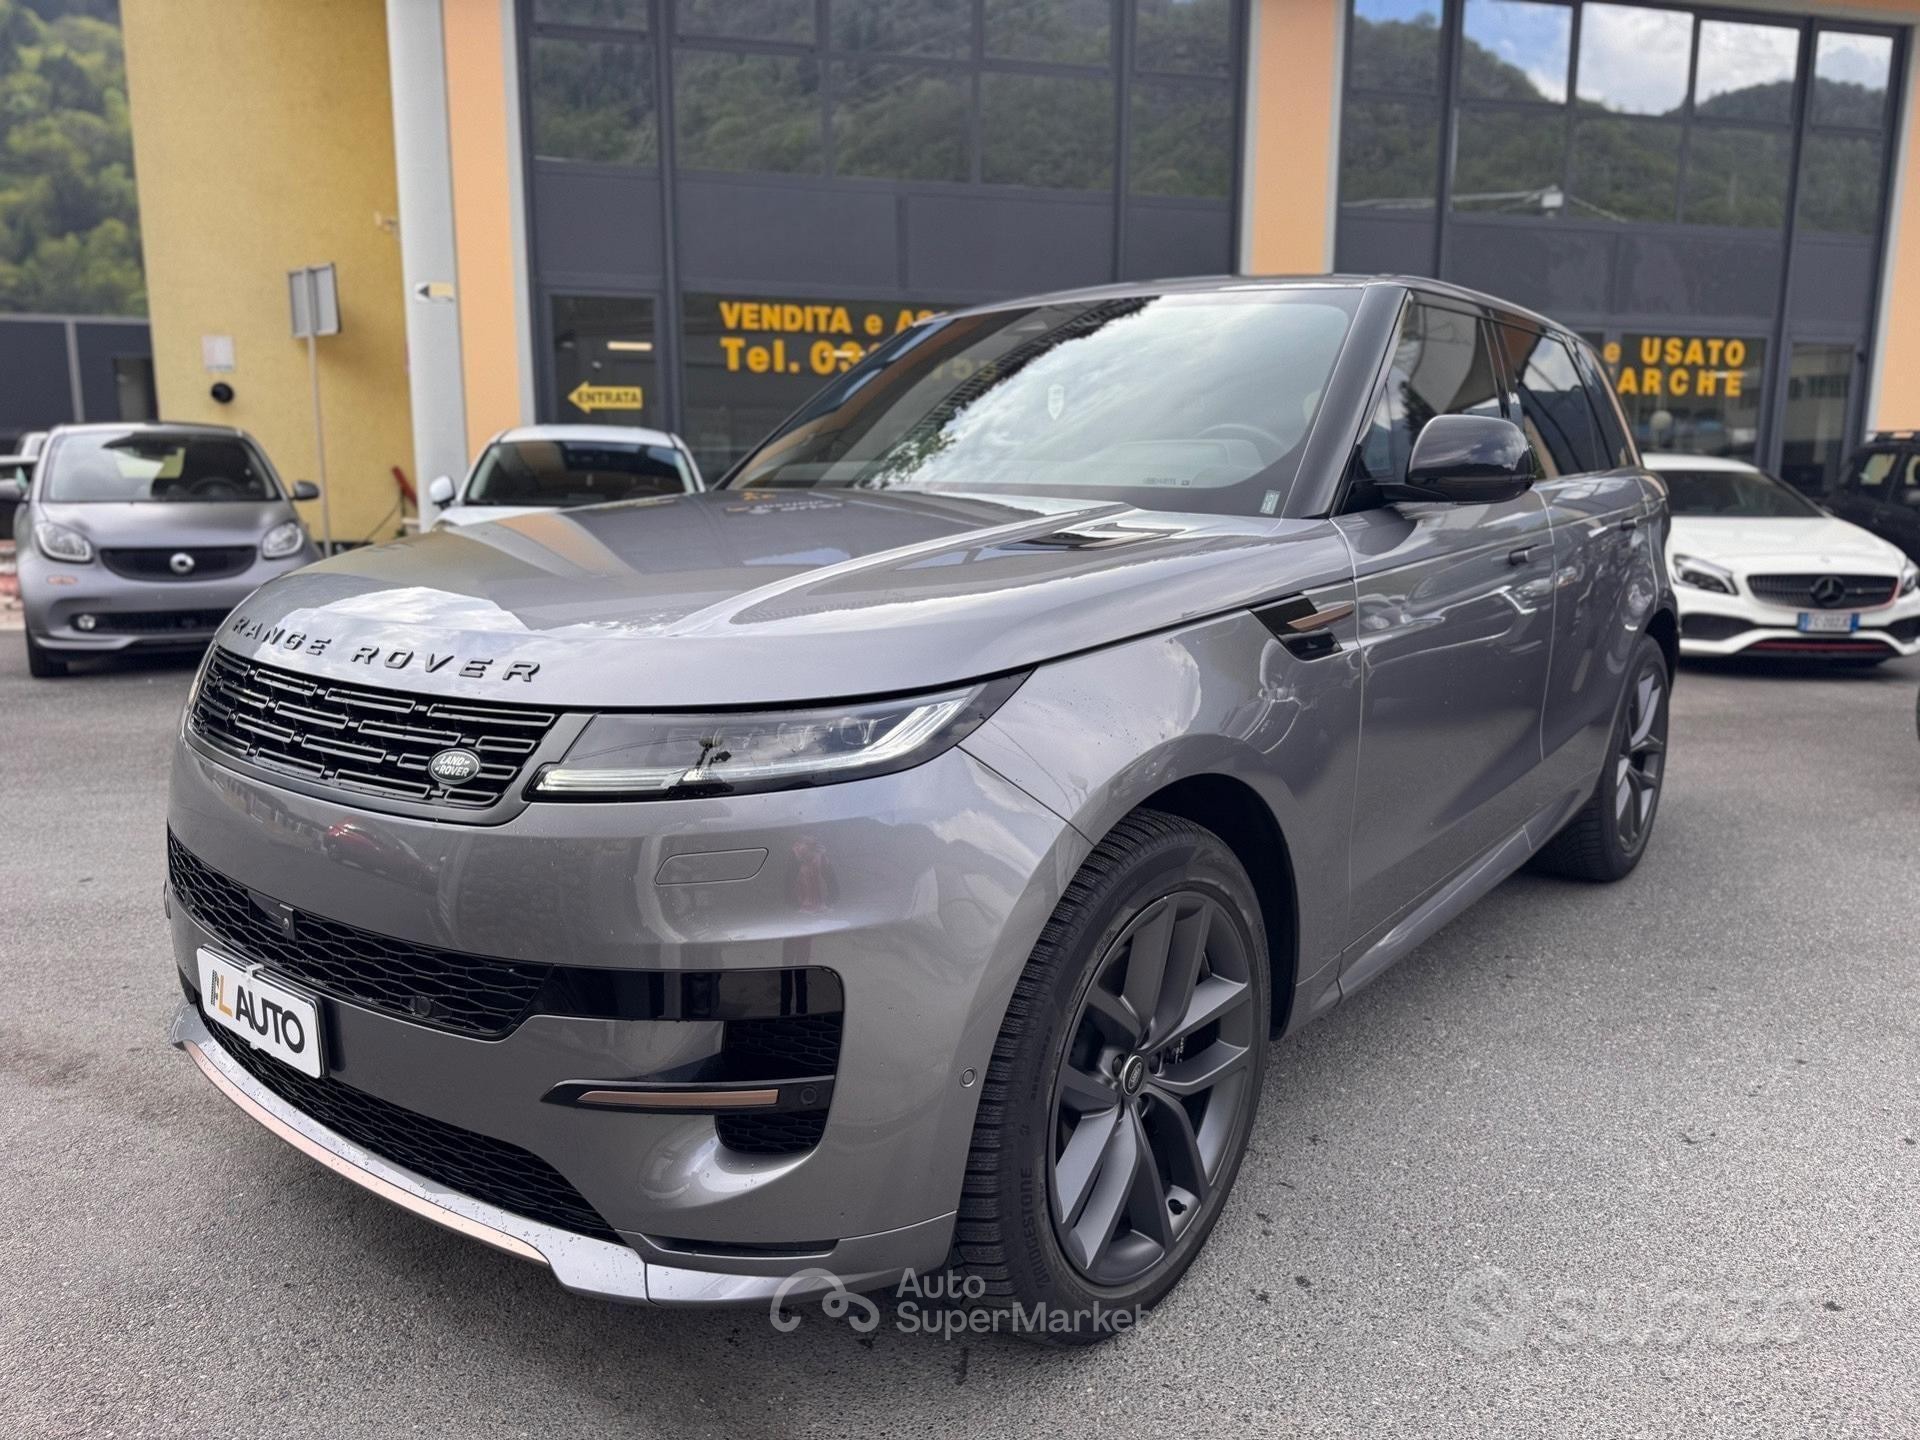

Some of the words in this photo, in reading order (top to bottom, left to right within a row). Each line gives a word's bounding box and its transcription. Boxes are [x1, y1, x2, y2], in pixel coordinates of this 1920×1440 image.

[719, 302, 852, 334] VENDITA
[864, 313, 883, 335] e
[720, 337, 800, 373] Tel.
[1603, 342, 1622, 365] e
[1641, 336, 1746, 367] USATO
[577, 391, 638, 403] ENTRATA
[1608, 366, 1745, 397] ARCHE
[232, 616, 332, 656] RANGE
[351, 646, 540, 682] ROVER
[438, 764, 470, 777] ROVER
[440, 755, 466, 766] LAND
[235, 984, 305, 1054] AUTO
